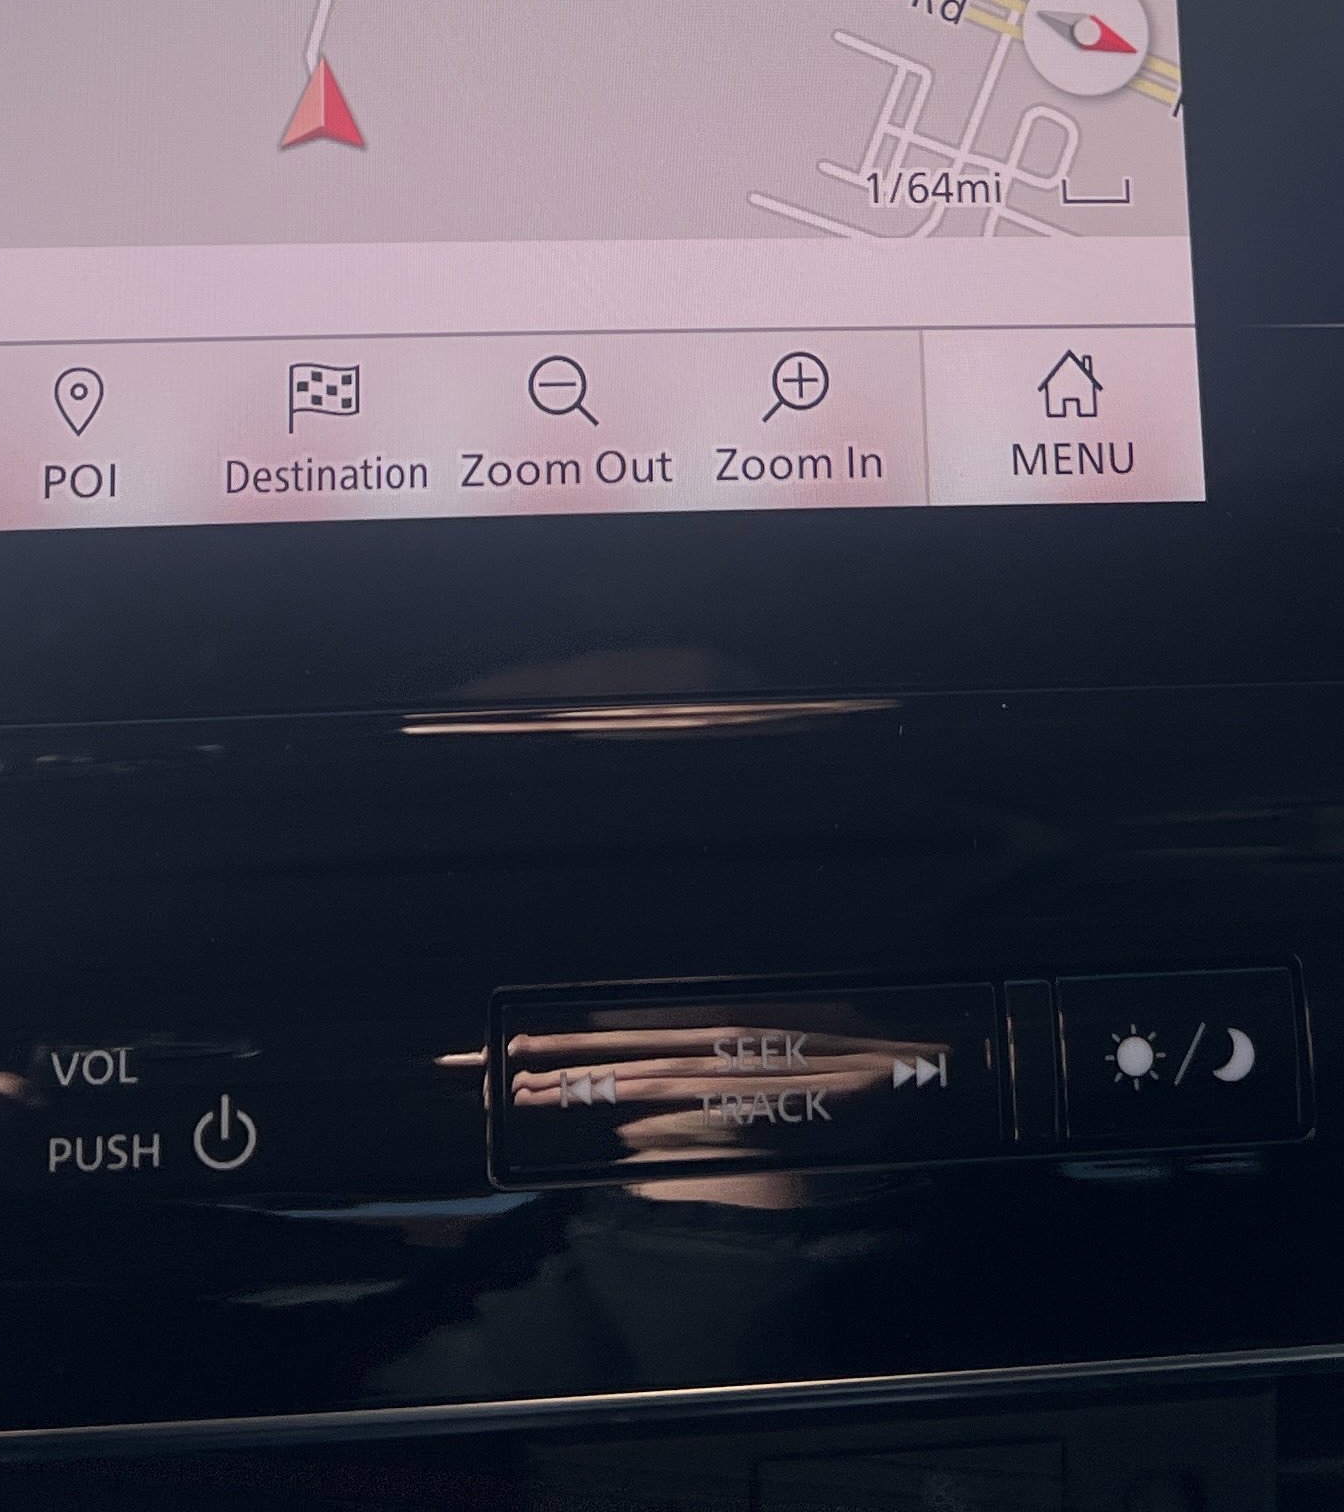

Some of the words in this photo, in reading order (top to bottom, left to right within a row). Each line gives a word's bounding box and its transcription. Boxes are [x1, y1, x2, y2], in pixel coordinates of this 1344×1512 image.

[865, 170, 1003, 206] 1/64mi
[225, 456, 429, 495] Destination
[460, 453, 581, 488] Zoom
[596, 448, 673, 485] Out
[715, 447, 833, 482] Zoom
[848, 445, 883, 480] In
[1012, 441, 1135, 477] MENU
[43, 462, 118, 501] POI
[51, 1048, 138, 1086] VOL
[712, 1033, 809, 1075] SEEK
[698, 1086, 834, 1128] TRACK
[48, 1133, 161, 1173] PUSH
